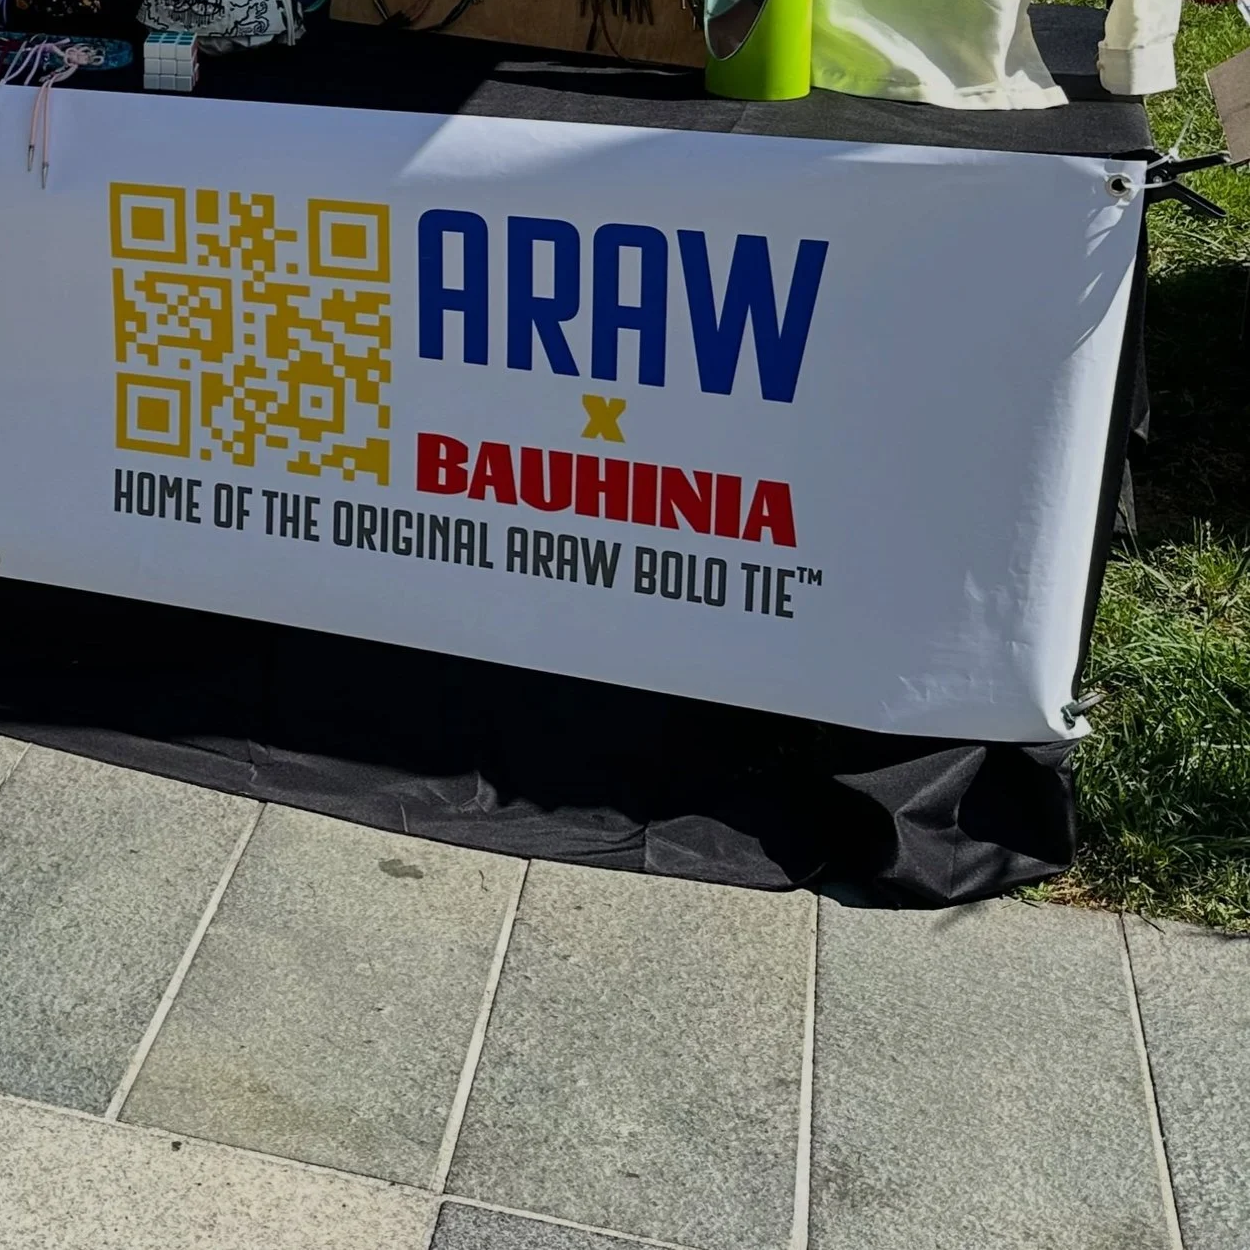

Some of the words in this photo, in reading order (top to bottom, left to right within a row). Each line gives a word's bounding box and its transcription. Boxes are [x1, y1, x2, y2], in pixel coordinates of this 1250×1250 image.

[418, 209, 829, 403] ARAW
[114, 469, 202, 524] HOME
[214, 483, 252, 530] OF
[262, 490, 320, 542] THE
[333, 500, 494, 569] ORIGINAL
[506, 526, 622, 589] ARAW
[634, 546, 727, 607] BOLO
[416, 432, 797, 548] BAUHINIA
